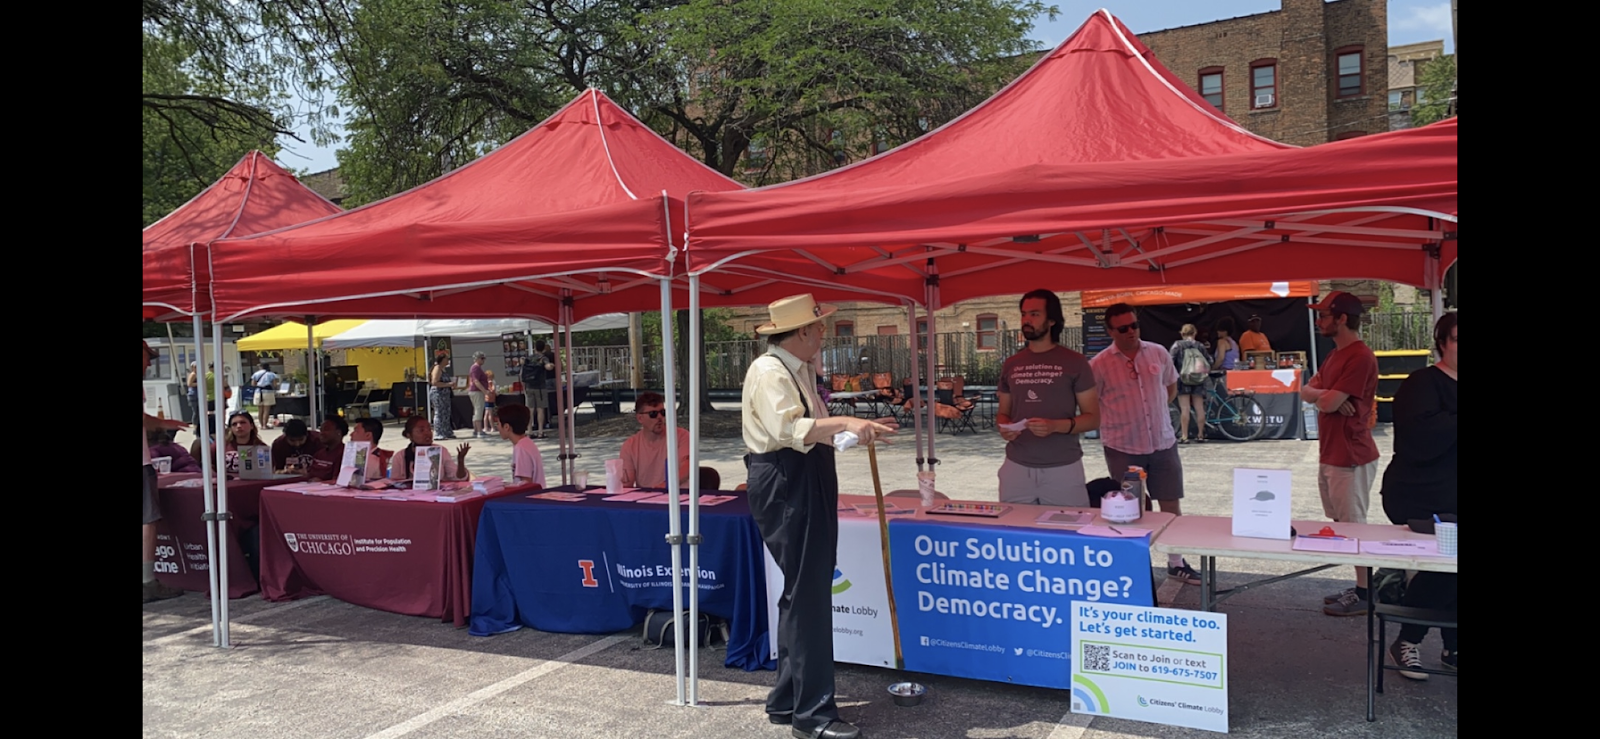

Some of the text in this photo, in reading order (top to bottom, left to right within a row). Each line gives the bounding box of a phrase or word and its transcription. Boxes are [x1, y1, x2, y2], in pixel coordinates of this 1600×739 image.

[183, 542, 204, 550] Urban
[299, 541, 351, 556] CHICAGO
[914, 535, 1113, 567] Our Solution to
[656, 565, 716, 580] Exenion
[916, 562, 1133, 601] Climate Change?
[851, 605, 878, 619] Lobby
[918, 591, 1063, 628] Democracy.
[1079, 606, 1221, 630] It's your climate too.
[1079, 621, 1197, 643] Let's get started.
[930, 638, 1006, 654] @CitizensClimateLobby
[1112, 650, 1207, 669] Scan to Join or text
[1112, 661, 1218, 681] JOIN to 619-675-7507
[1177, 702, 1203, 711] Climate
[1204, 705, 1224, 715] Lobby
